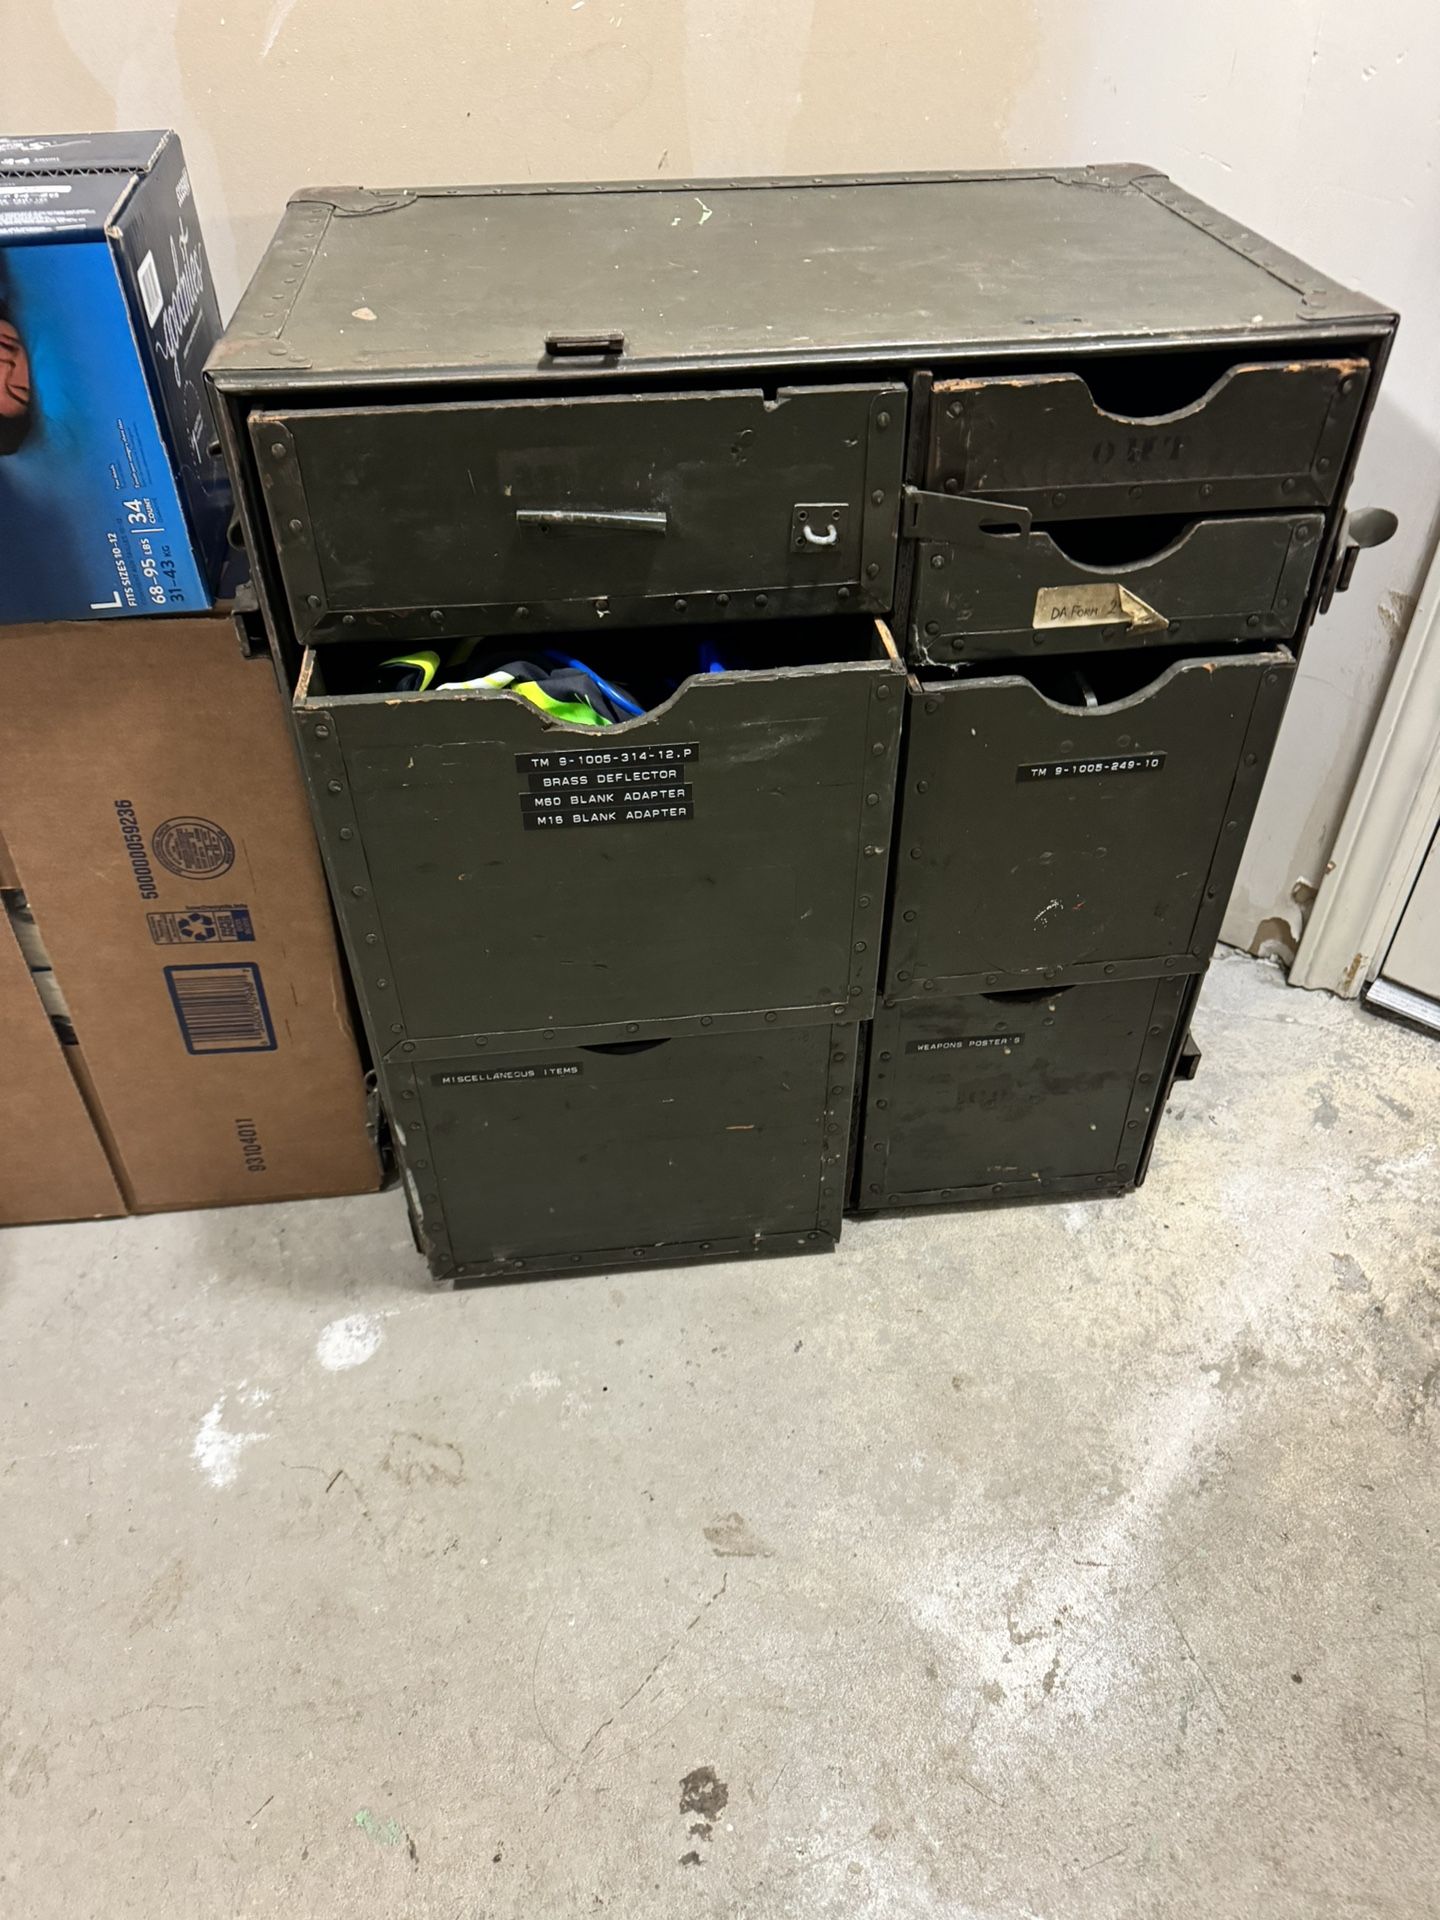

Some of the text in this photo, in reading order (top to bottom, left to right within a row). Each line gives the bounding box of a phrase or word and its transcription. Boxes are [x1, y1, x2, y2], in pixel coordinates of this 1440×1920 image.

[123, 499, 147, 524] 34
[143, 498, 156, 524] COUNT
[162, 545, 171, 557] KG
[116, 560, 131, 586] SIZES
[141, 538, 166, 604] 68-95 LBS
[91, 591, 122, 609] L
[124, 587, 137, 606] FITS
[1051, 607, 1067, 620] DA
[531, 758, 550, 768] TM
[1031, 759, 1159, 777] TM 9-1005-249-10
[543, 769, 677, 788] BRASS DEFLECTOR
[534, 789, 685, 807] M60 BLANK ADAPTER
[537, 808, 687, 825] M16 BLANK ADAPTER
[114, 800, 159, 899] 500000059236
[917, 1041, 962, 1051] WEAPONS
[442, 1066, 578, 1084] MISCELLANEOUS ITEMS
[235, 1118, 267, 1172] 93104011
